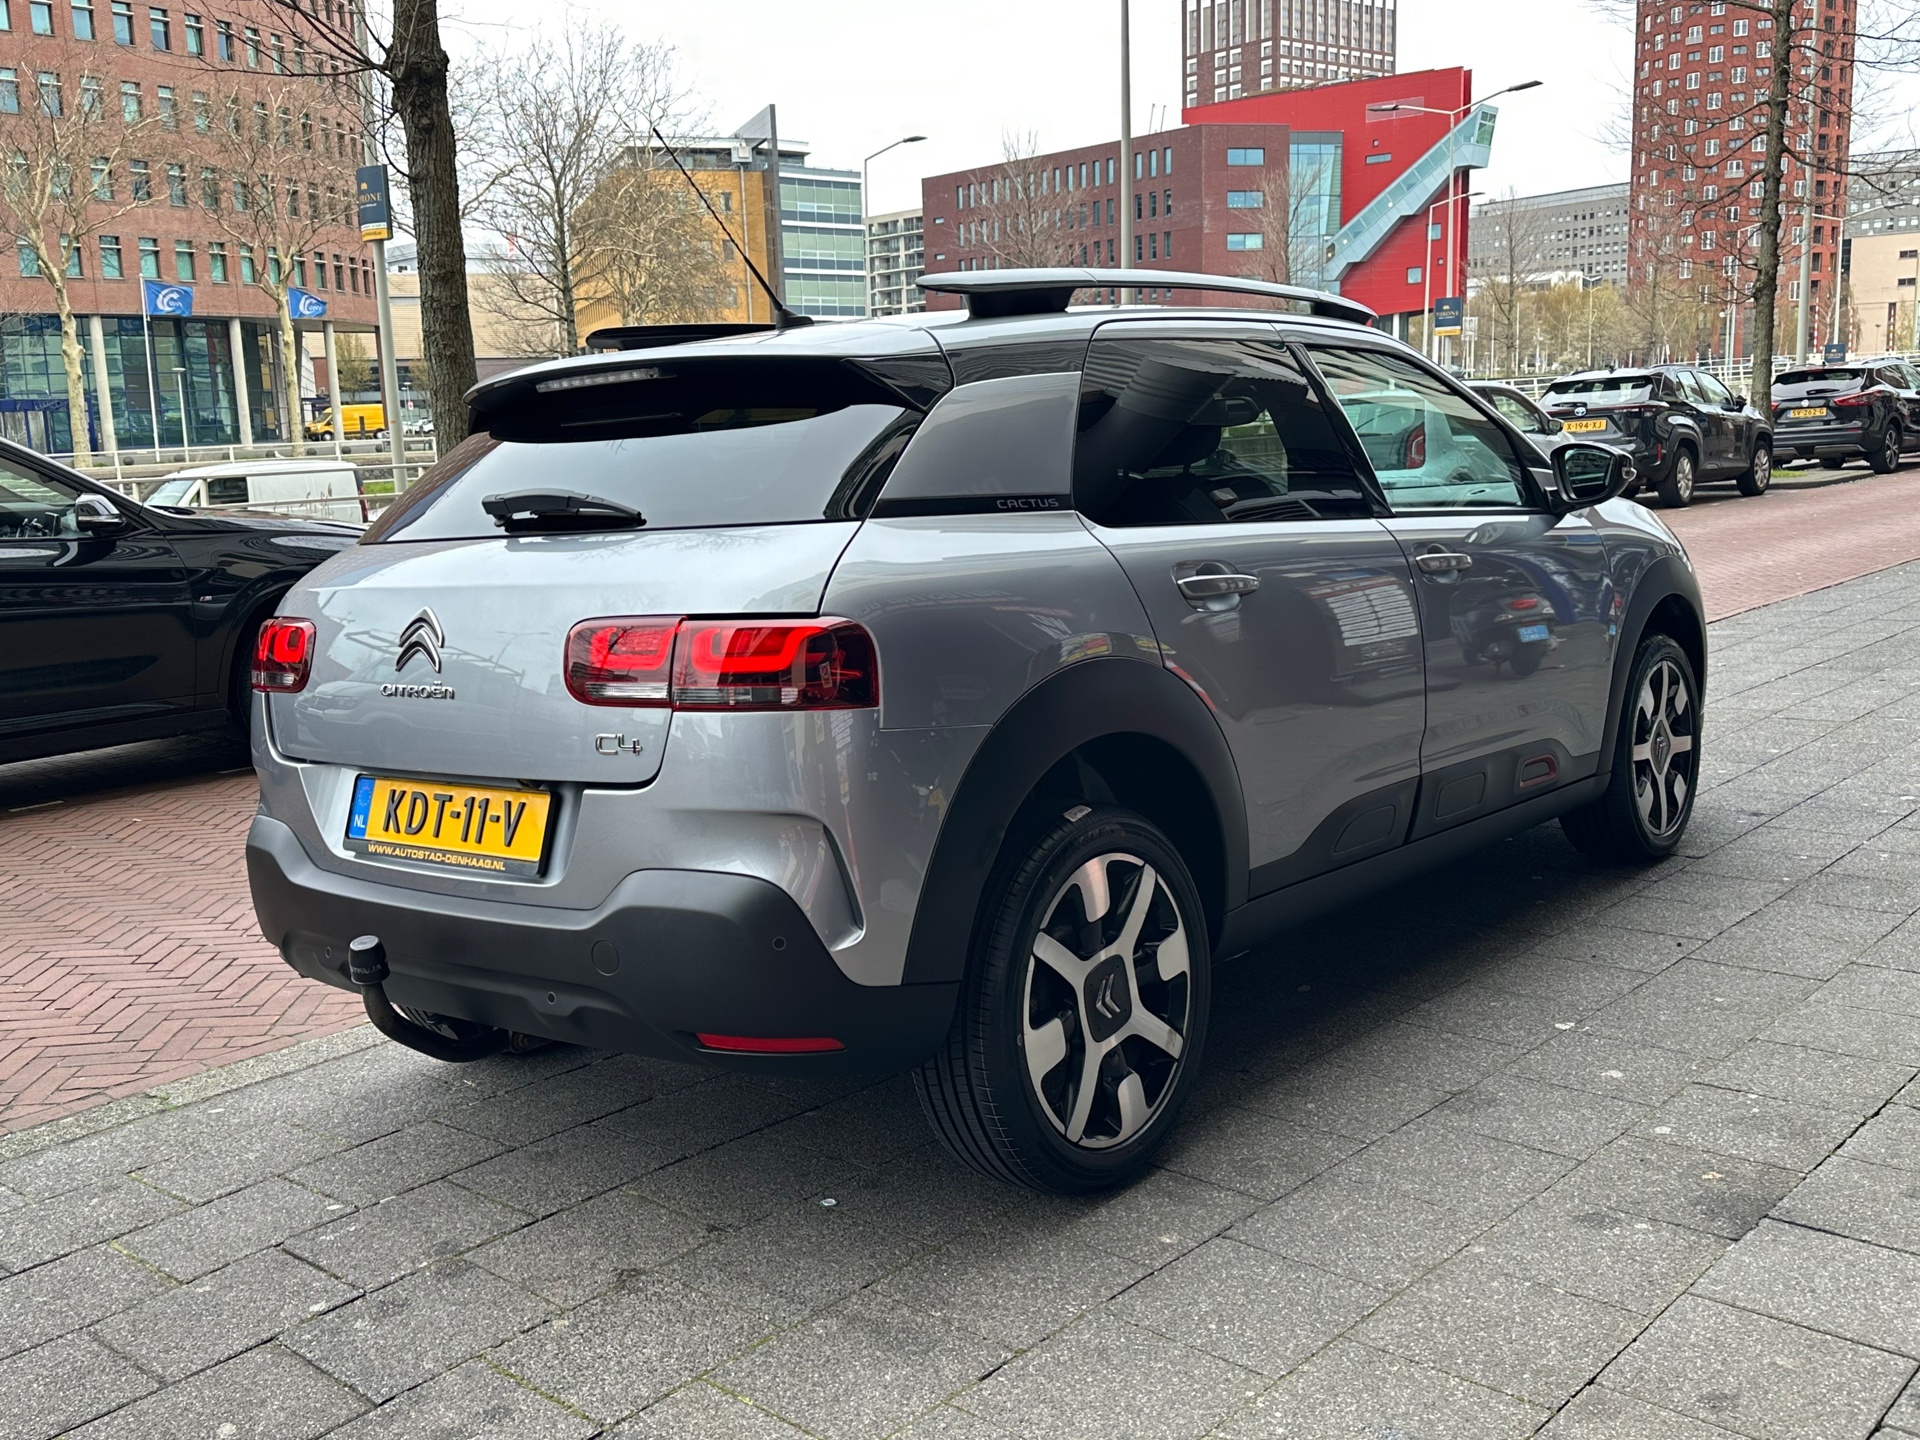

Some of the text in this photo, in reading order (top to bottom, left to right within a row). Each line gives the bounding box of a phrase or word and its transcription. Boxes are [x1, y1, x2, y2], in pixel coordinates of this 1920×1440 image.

[996, 498, 1059, 509] CACTUS
[595, 733, 643, 756] C4
[354, 814, 366, 828] NL
[382, 788, 527, 848] KDT-11-V
[368, 843, 506, 871] WWW.AUTOSTAD-DENHAAG.NL
